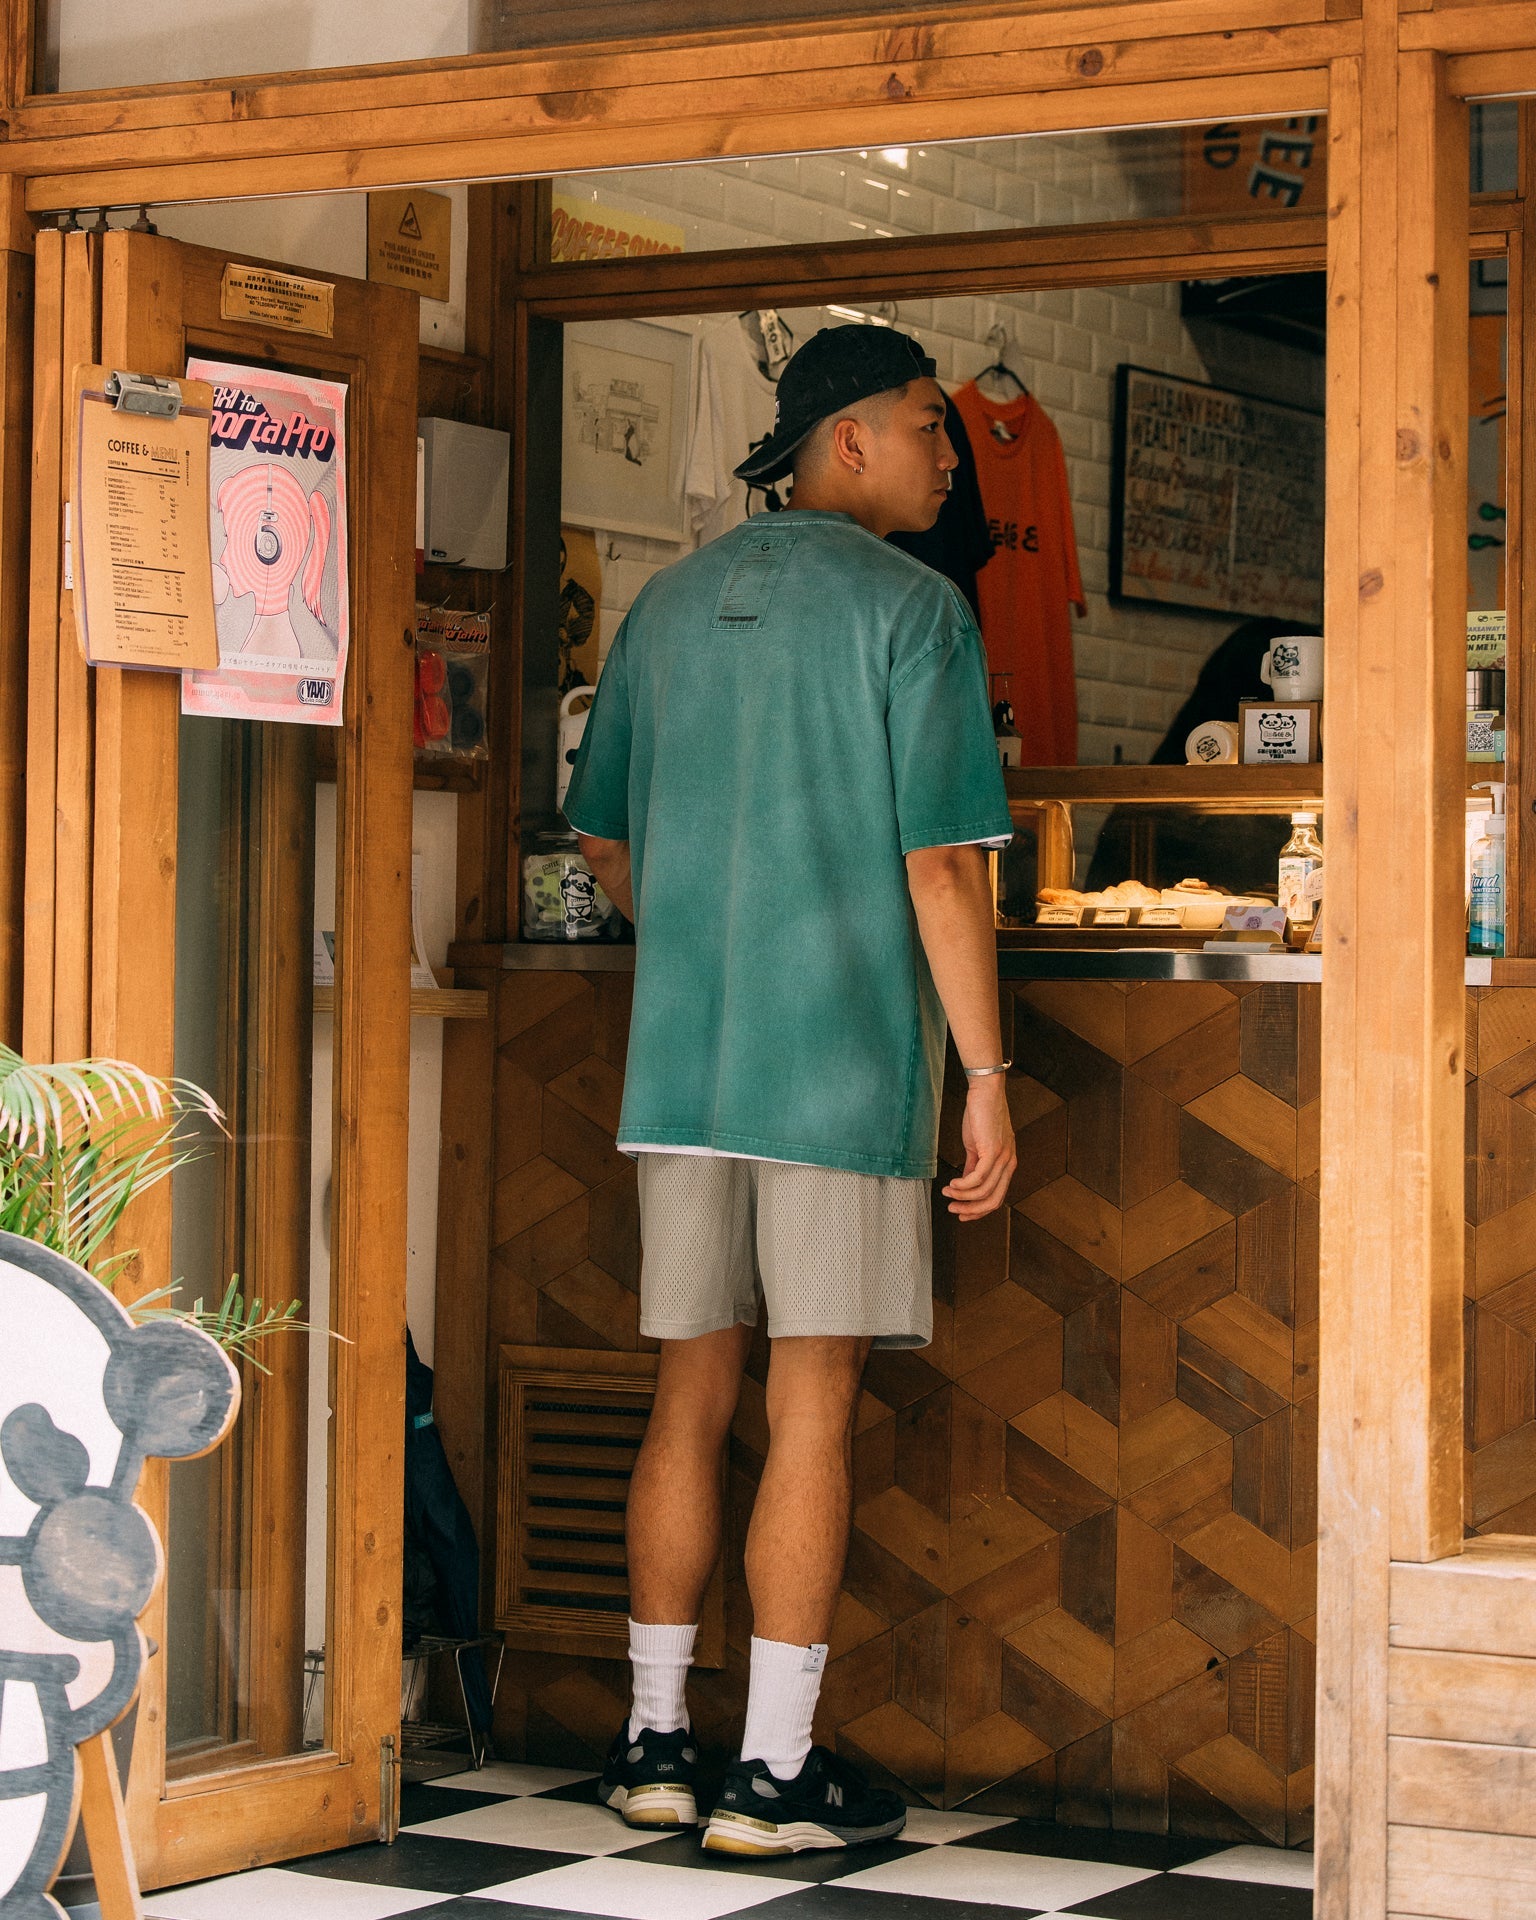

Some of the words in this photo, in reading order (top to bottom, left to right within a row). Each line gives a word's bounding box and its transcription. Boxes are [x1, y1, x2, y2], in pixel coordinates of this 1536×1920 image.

[386, 250, 400, 260] HOUR
[397, 244, 410, 254] AREA
[418, 249, 435, 260] UNDER
[240, 395, 261, 412] for
[108, 440, 140, 455] COFFEE
[142, 444, 149, 456] &
[151, 446, 178, 459] MENU
[761, 542, 770, 551] G
[306, 680, 326, 699] YAXI
[826, 1782, 843, 1808] N
